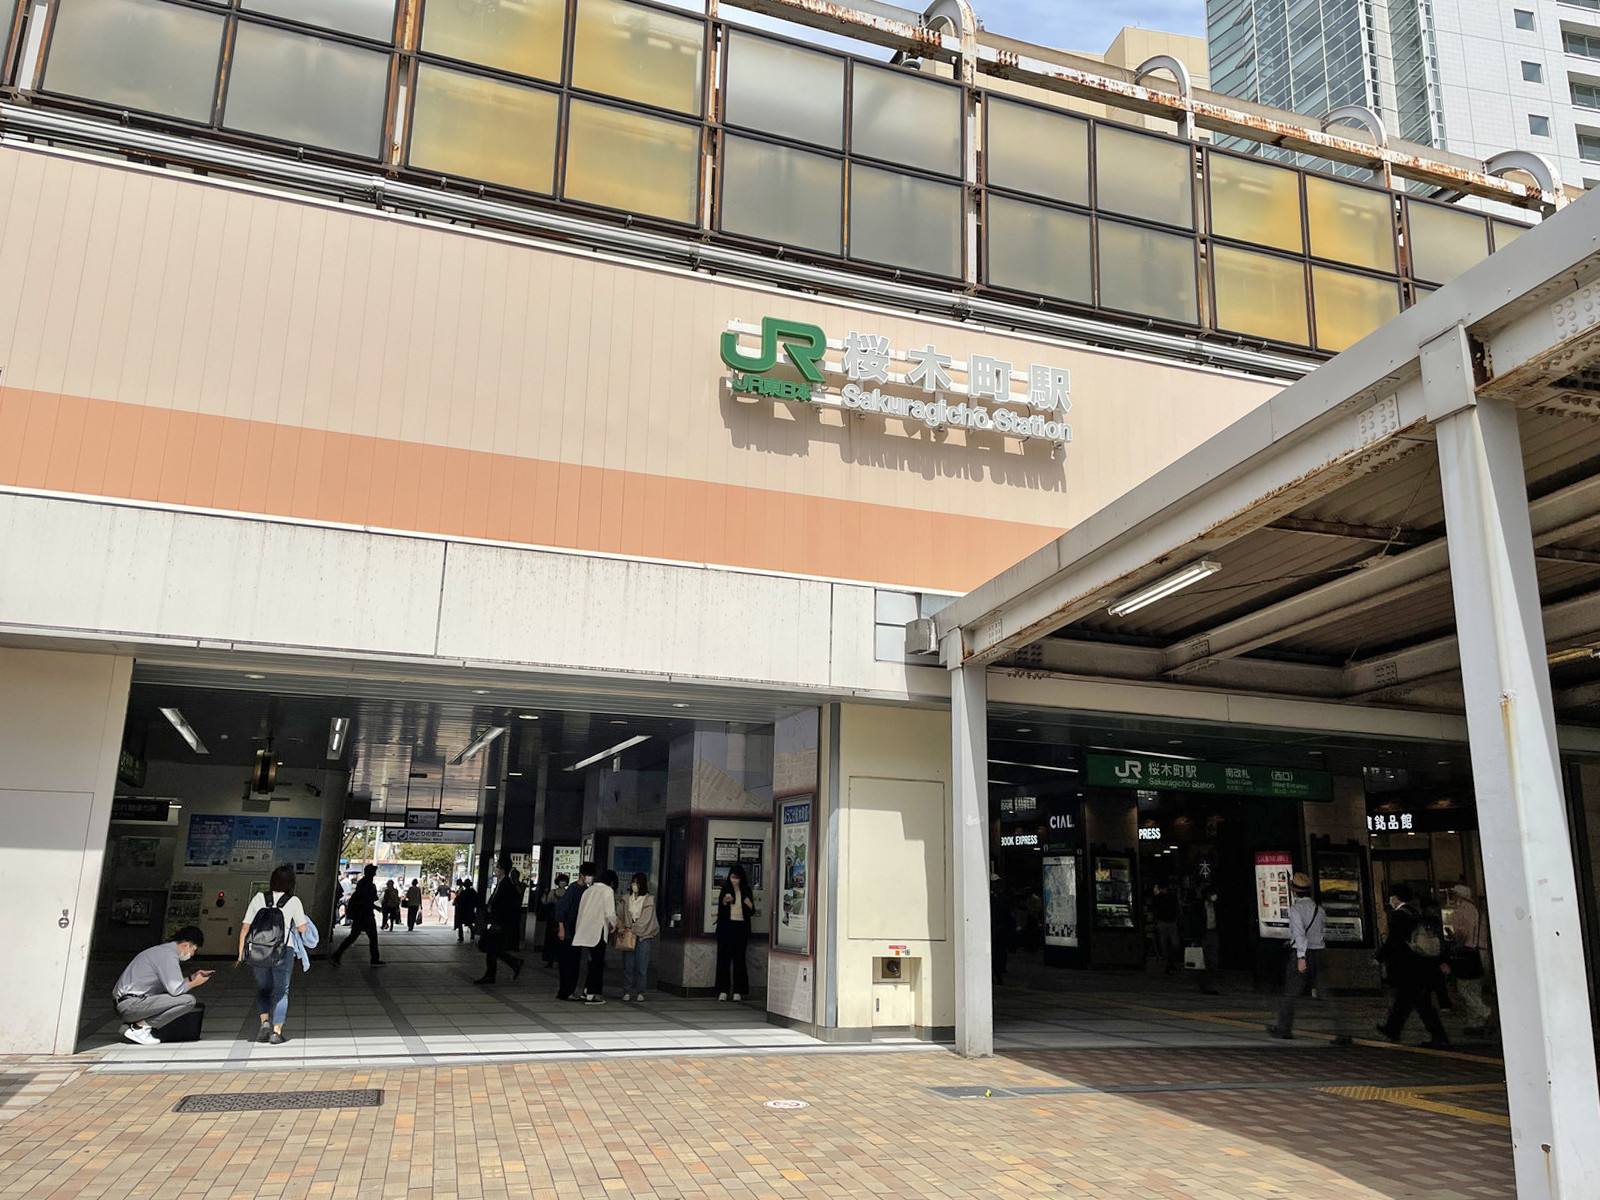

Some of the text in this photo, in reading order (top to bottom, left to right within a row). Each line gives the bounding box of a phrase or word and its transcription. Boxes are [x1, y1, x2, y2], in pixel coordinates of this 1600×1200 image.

[720, 316, 827, 383] JR
[842, 330, 1072, 413] 桜木町駅
[733, 374, 812, 402] JR東日本
[991, 408, 1073, 443] Station
[1115, 760, 1142, 779] JR
[1148, 761, 1198, 779] 桜木町駅
[1225, 767, 1250, 779] 南改札
[1191, 779, 1216, 790] Station
[1015, 834, 1039, 846] EXPRESS
